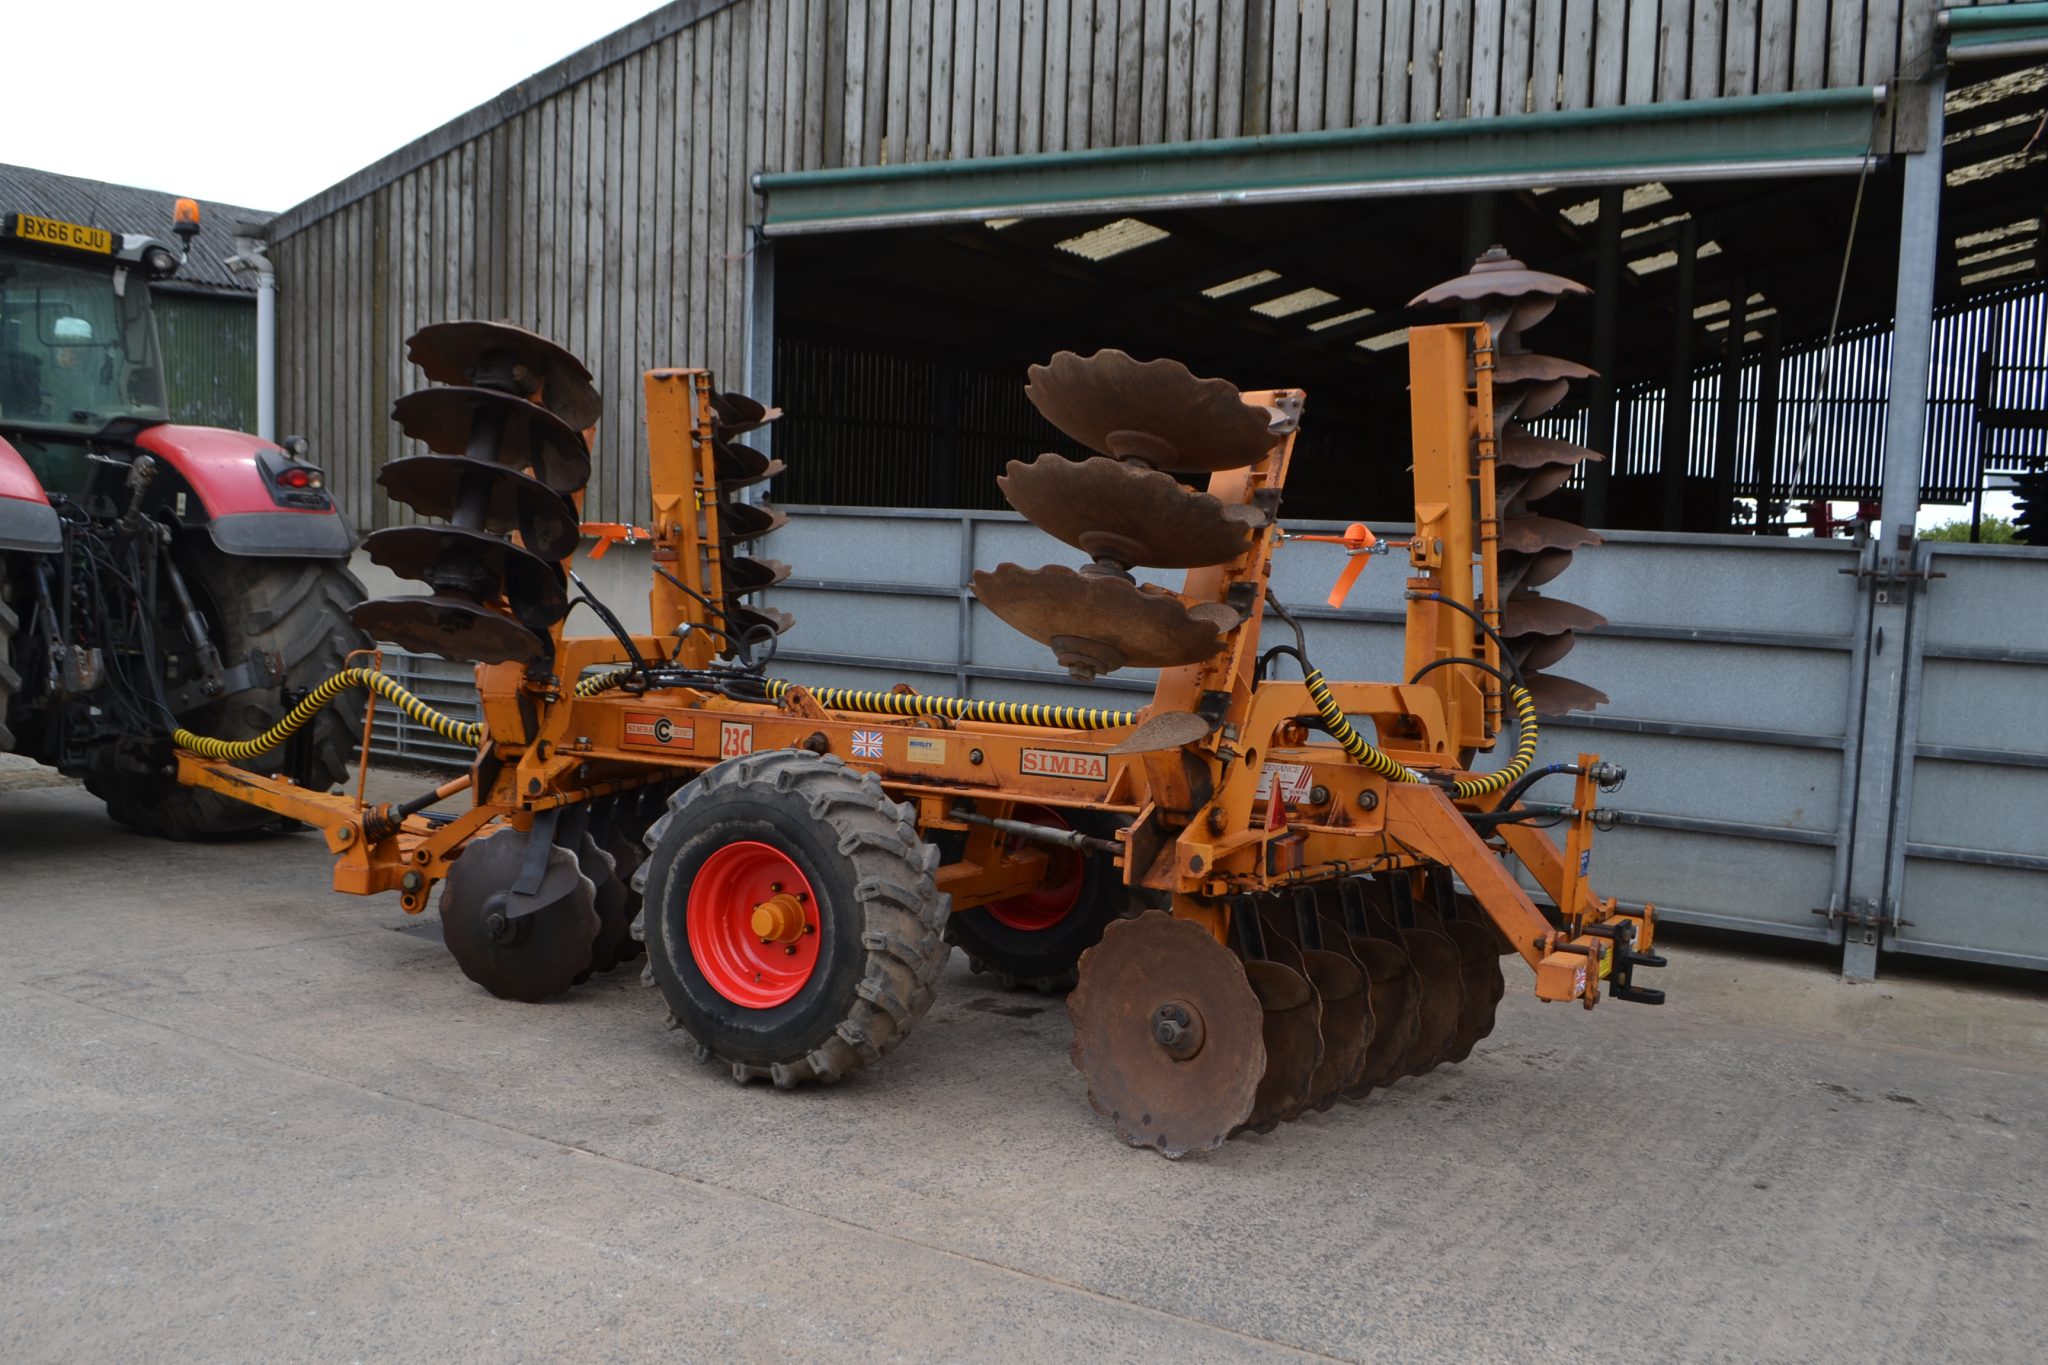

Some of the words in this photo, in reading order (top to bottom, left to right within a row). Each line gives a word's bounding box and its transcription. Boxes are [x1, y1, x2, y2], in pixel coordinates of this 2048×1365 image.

[24, 218, 68, 241] BX66
[73, 228, 104, 248] GJU
[655, 718, 673, 744] C
[723, 727, 750, 756] 23C
[1023, 753, 1104, 777] SIMBA
